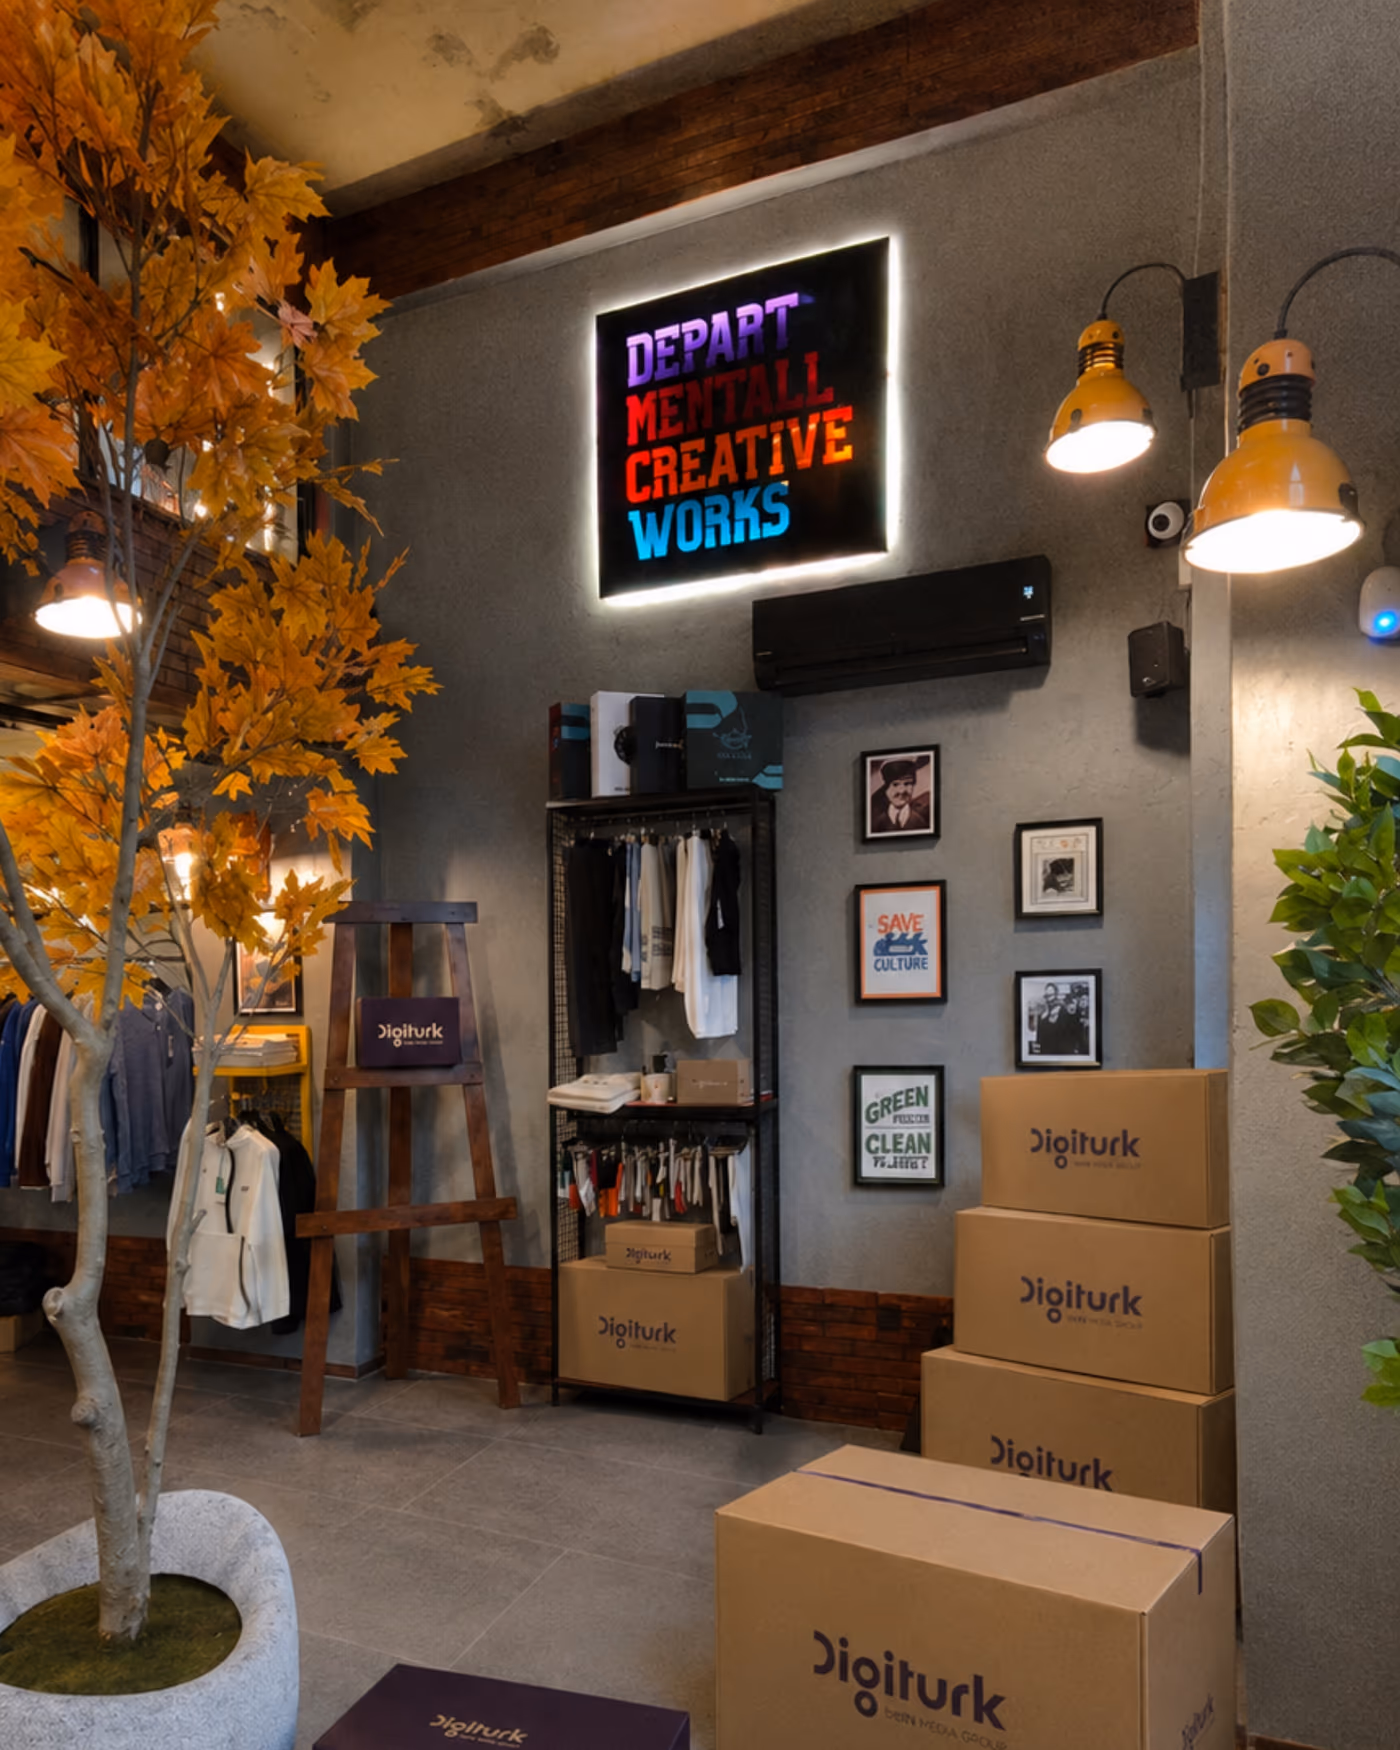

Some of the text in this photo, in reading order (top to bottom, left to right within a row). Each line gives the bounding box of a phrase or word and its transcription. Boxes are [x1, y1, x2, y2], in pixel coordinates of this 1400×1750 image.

[626, 292, 799, 388] DEPART
[626, 351, 834, 446] MENTALL
[626, 405, 853, 504] CREATIVE
[628, 480, 790, 561] WORKS
[877, 912, 925, 935] SAVE
[873, 956, 929, 972] CULTURE
[378, 1022, 443, 1048] Digiturk
[865, 1085, 929, 1124] GREEN
[865, 1132, 931, 1154] CLEAN
[1030, 1127, 1141, 1169] Digiturk
[1020, 1276, 1143, 1324] Digiturk
[598, 1315, 677, 1349] Digiturk
[813, 1629, 1006, 1731] Digiturk
[429, 1714, 529, 1743] Digiturk
